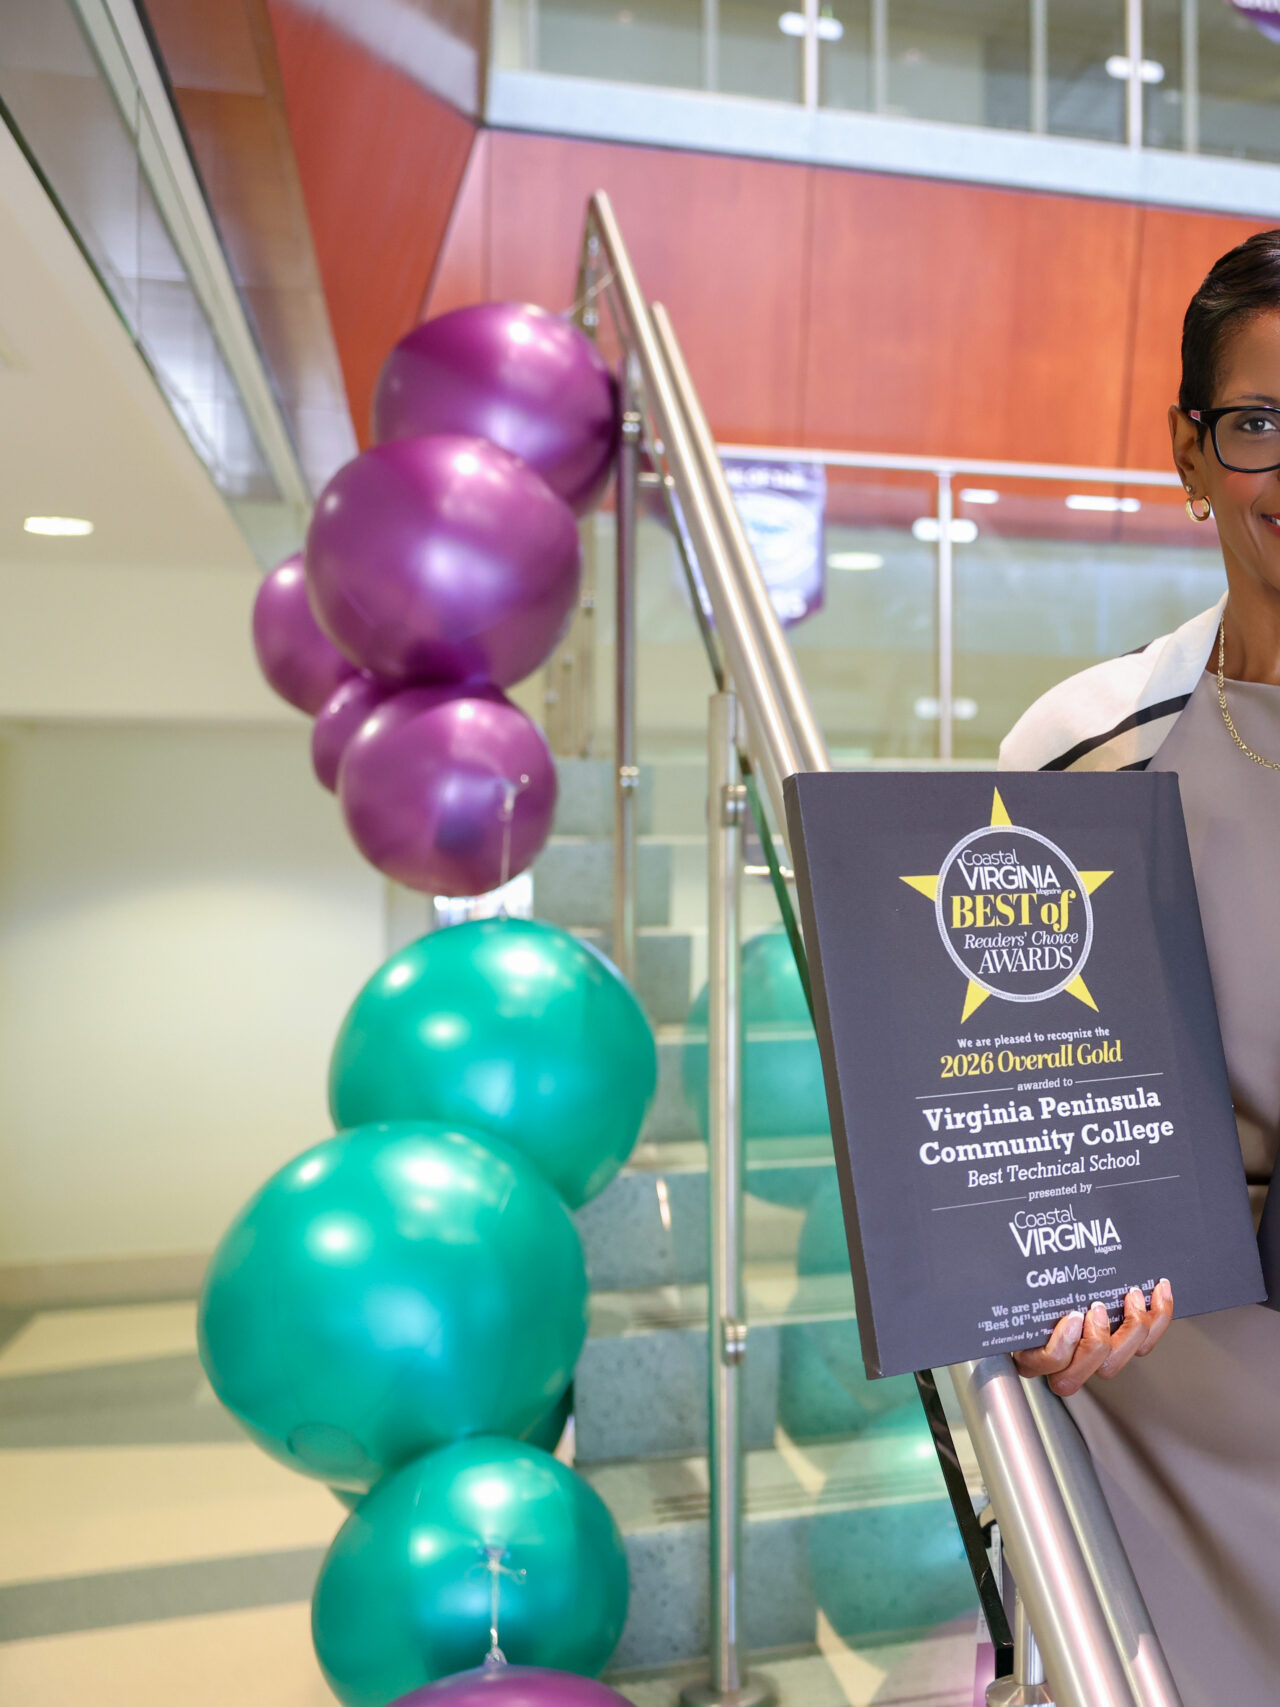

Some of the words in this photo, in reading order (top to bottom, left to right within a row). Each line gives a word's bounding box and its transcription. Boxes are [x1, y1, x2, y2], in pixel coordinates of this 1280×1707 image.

[961, 848, 1020, 866] Coastal
[957, 858, 1061, 891] VIRGINIA
[1036, 888, 1062, 897] Magazine
[950, 892, 1038, 929] BEST
[1040, 889, 1077, 933] of
[1031, 930, 1079, 946] Choice
[977, 946, 1074, 975] AWARDS
[957, 1038, 973, 1049] We
[975, 1037, 992, 1047] are
[994, 1033, 1032, 1049] pleased
[1034, 1032, 1045, 1042] to
[1047, 1029, 1092, 1044] recognize
[1094, 1026, 1110, 1037] the
[940, 1051, 994, 1079] 2026
[997, 1043, 1074, 1073] Overall
[1076, 1039, 1123, 1066] Gold
[1017, 1079, 1061, 1092] awarded
[1062, 1077, 1073, 1088] to
[922, 1100, 1035, 1134] Virginia
[1038, 1086, 1161, 1120] Peninsula
[918, 1128, 1075, 1166] Community
[1081, 1119, 1175, 1147] College
[967, 1168, 1004, 1188] Best
[1006, 1157, 1085, 1183] Technical
[1089, 1149, 1141, 1173] School
[1028, 1184, 1078, 1201] presented
[1079, 1182, 1093, 1194] by
[1014, 1203, 1077, 1229] Coastal
[1008, 1217, 1121, 1258] VIRGINIA
[1094, 1243, 1122, 1254] Magazine
[1026, 1263, 1117, 1288] CoVaMag.com
[991, 1305, 1009, 1318] We
[1011, 1302, 1030, 1314] are
[1032, 1293, 1074, 1314] pleased
[1075, 1291, 1087, 1302] to
[1141, 1279, 1155, 1291] all
